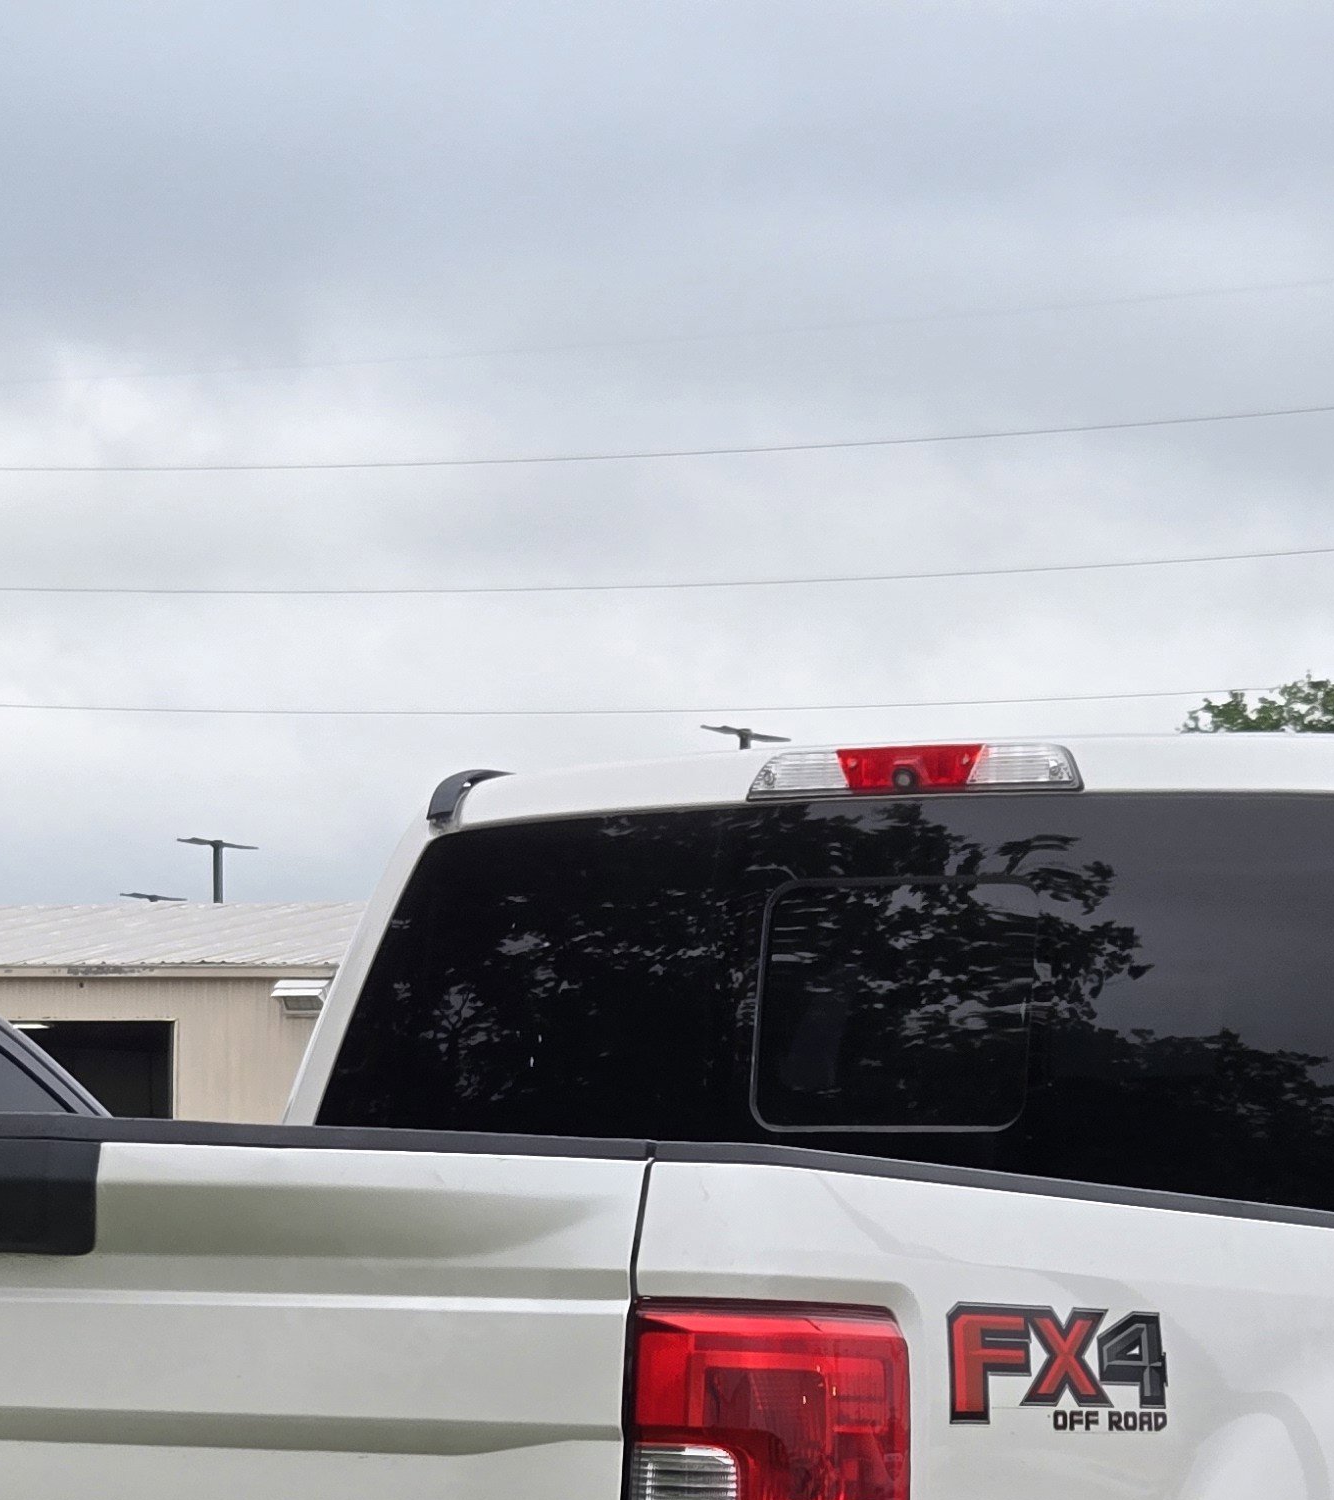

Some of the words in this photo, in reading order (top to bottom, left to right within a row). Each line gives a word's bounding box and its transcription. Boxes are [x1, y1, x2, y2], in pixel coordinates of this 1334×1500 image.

[946, 1301, 1168, 1425] FX4
[1053, 1410, 1099, 1431] OFF
[1108, 1411, 1168, 1432] ROAD
